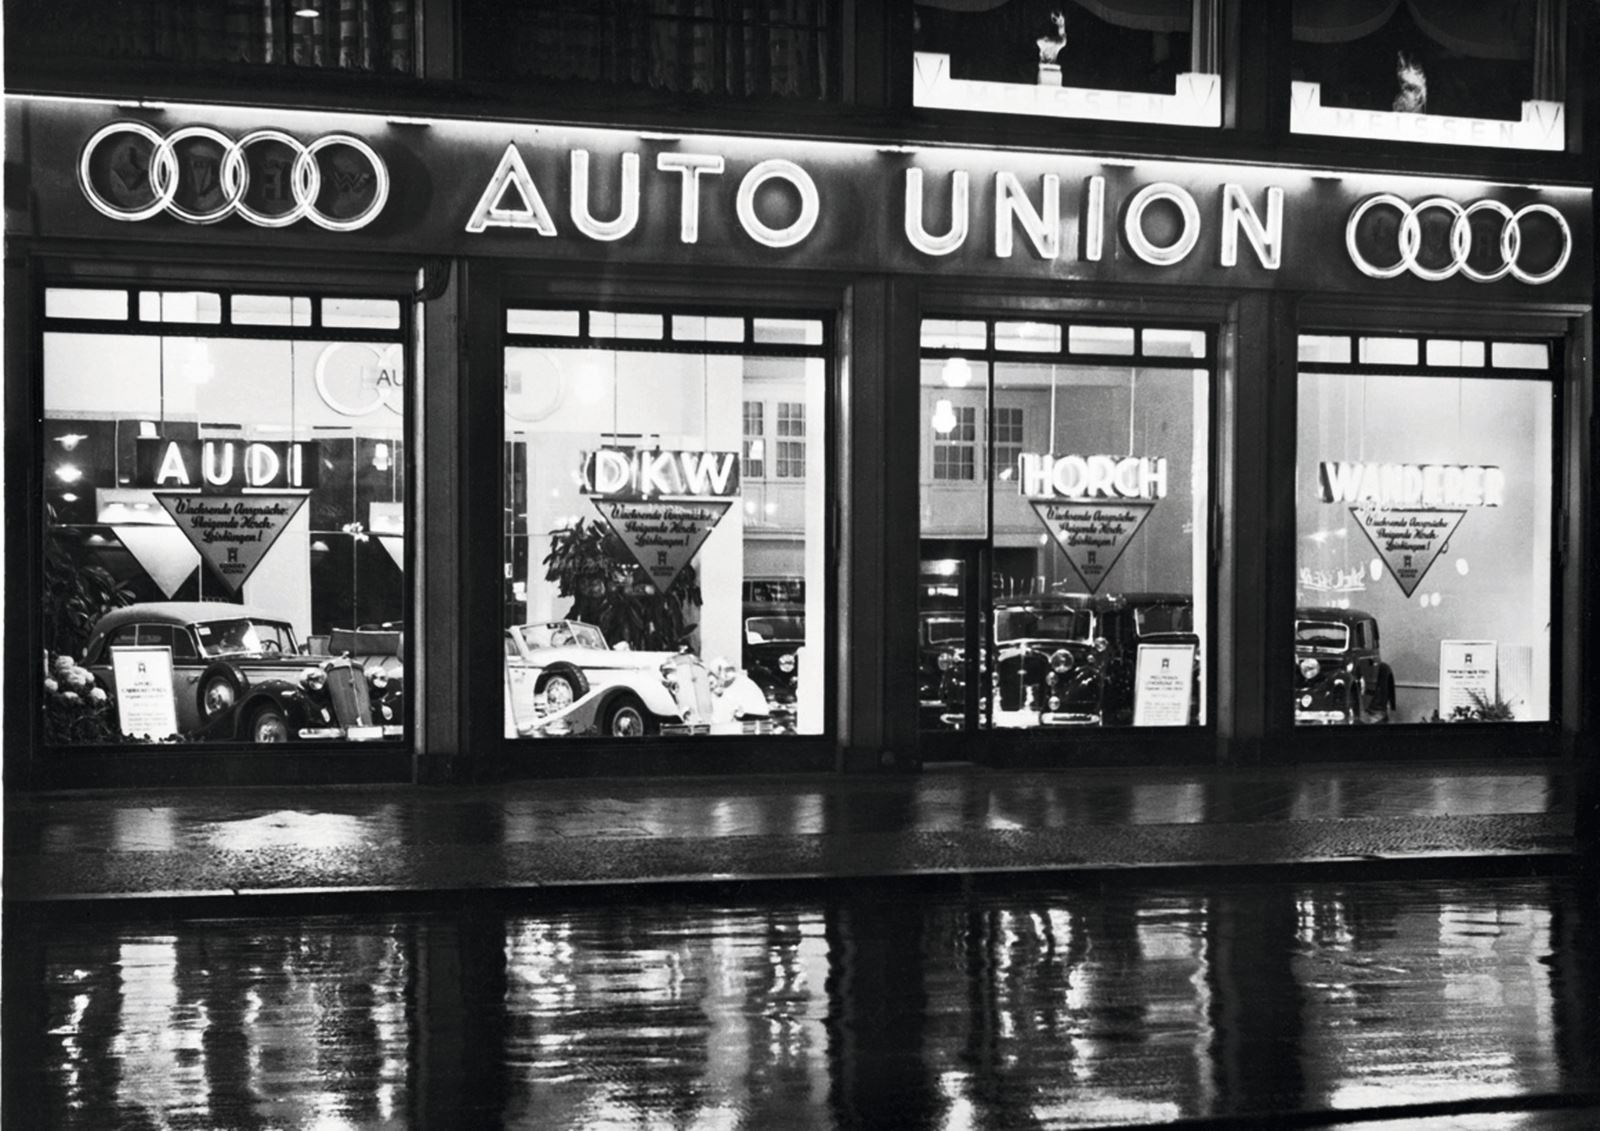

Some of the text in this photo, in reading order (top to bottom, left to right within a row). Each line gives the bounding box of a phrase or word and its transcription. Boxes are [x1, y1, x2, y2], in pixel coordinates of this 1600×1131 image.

[965, 83, 1164, 115] MEISSEN
[1336, 111, 1514, 144] MEISSEN
[466, 143, 1284, 270] AUTO UNION
[156, 441, 302, 486] AUDI
[594, 450, 735, 494] DKW
[1023, 454, 1167, 499] HORCH
[1326, 461, 1505, 507] WANDERER
